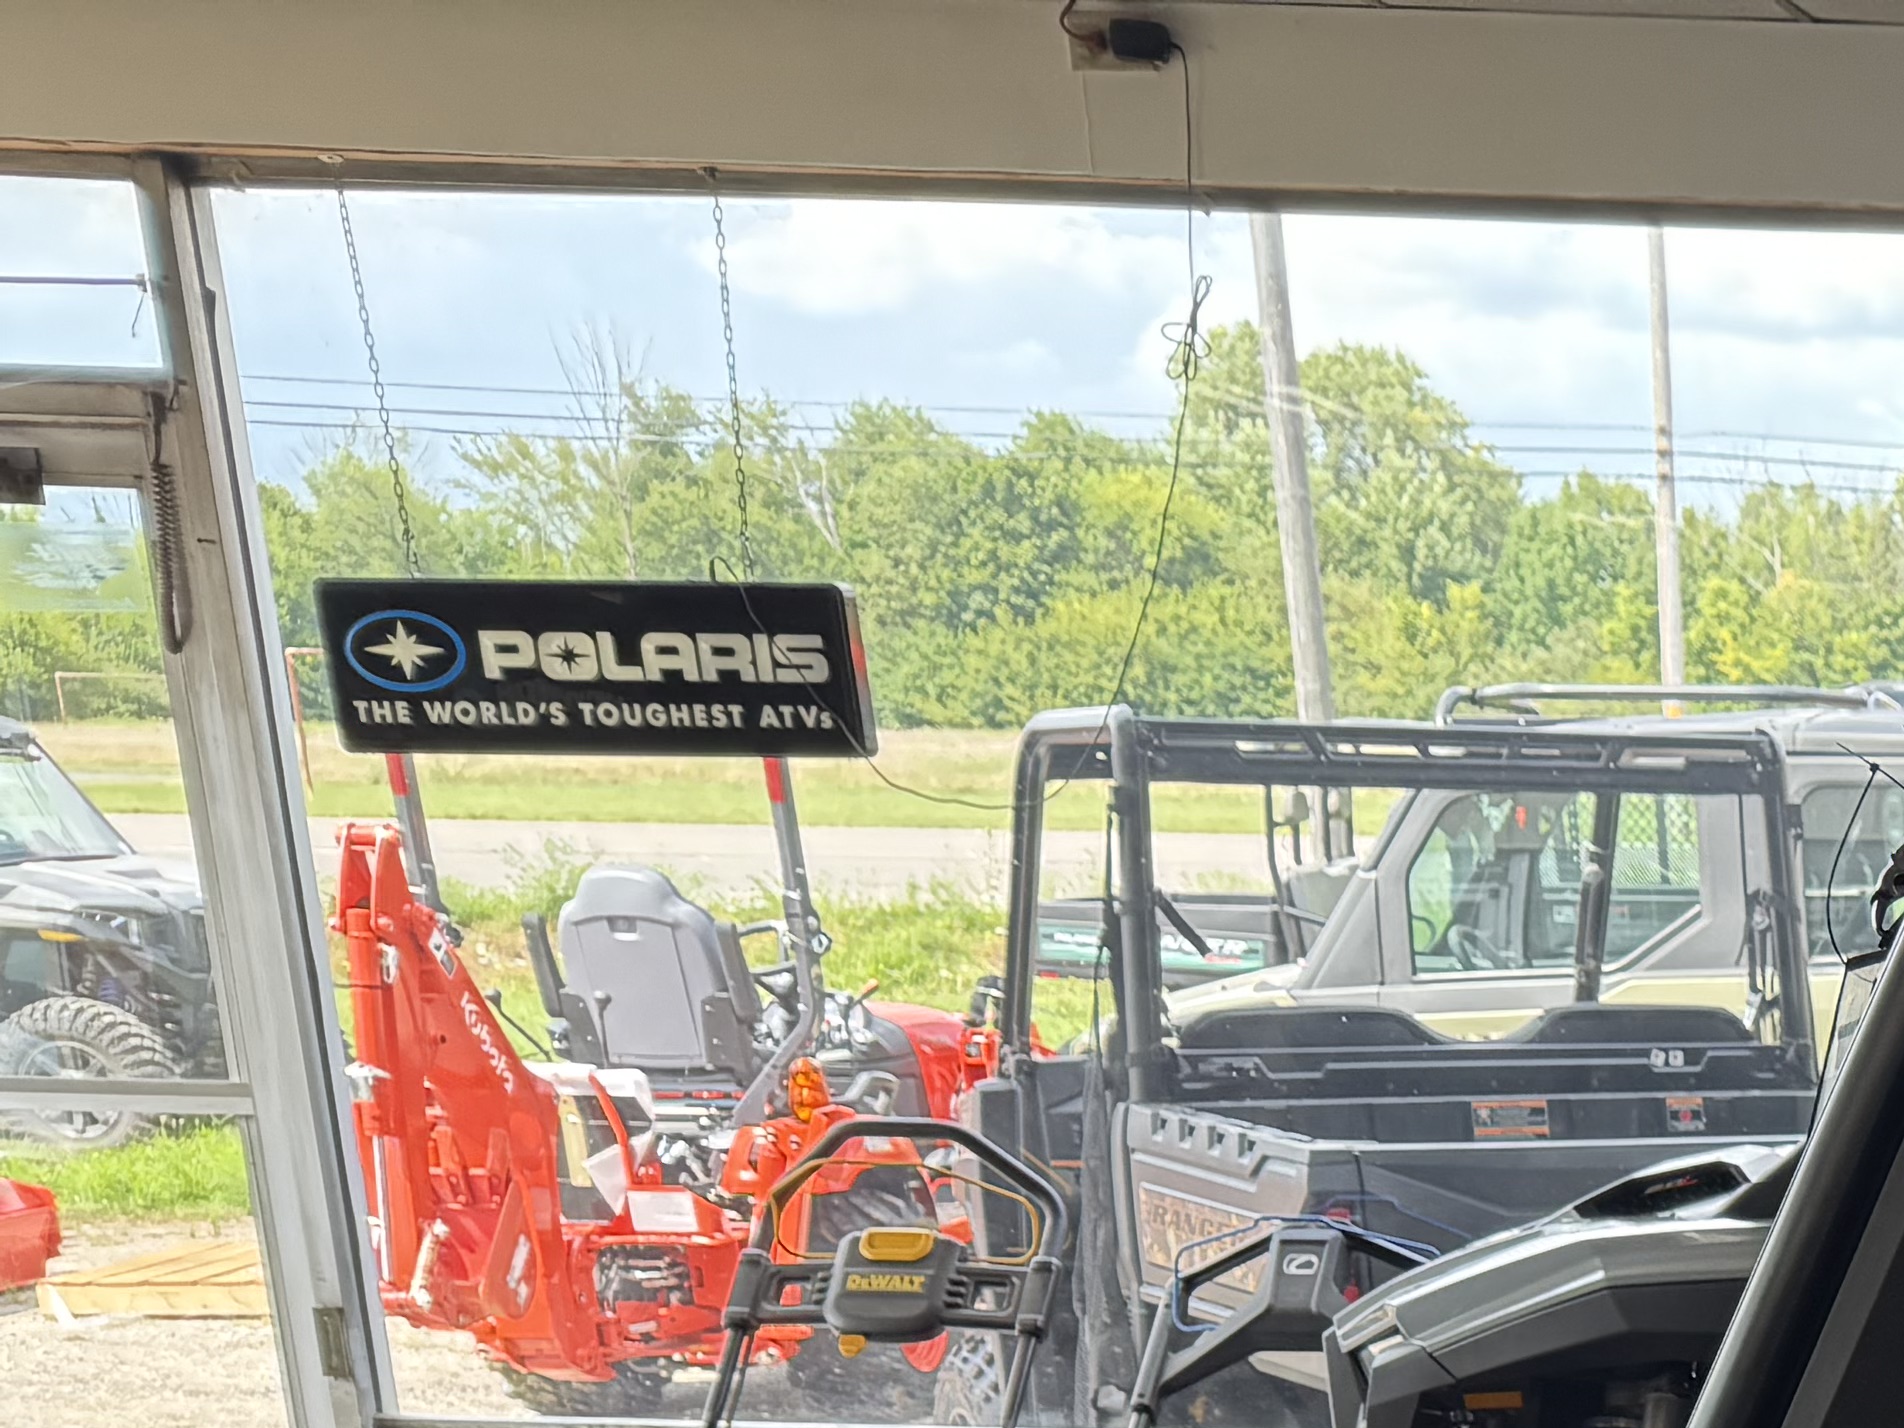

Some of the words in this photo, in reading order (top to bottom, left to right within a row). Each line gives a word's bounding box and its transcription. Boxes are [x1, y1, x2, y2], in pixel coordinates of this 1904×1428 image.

[477, 629, 831, 684] POLARIS
[353, 700, 412, 724] THE
[424, 701, 567, 727] WORLD'S
[578, 703, 745, 729] TOUGHEST
[759, 705, 834, 731] ATVs
[459, 990, 515, 1095] Kubota
[846, 1273, 926, 1293] DEWALT
